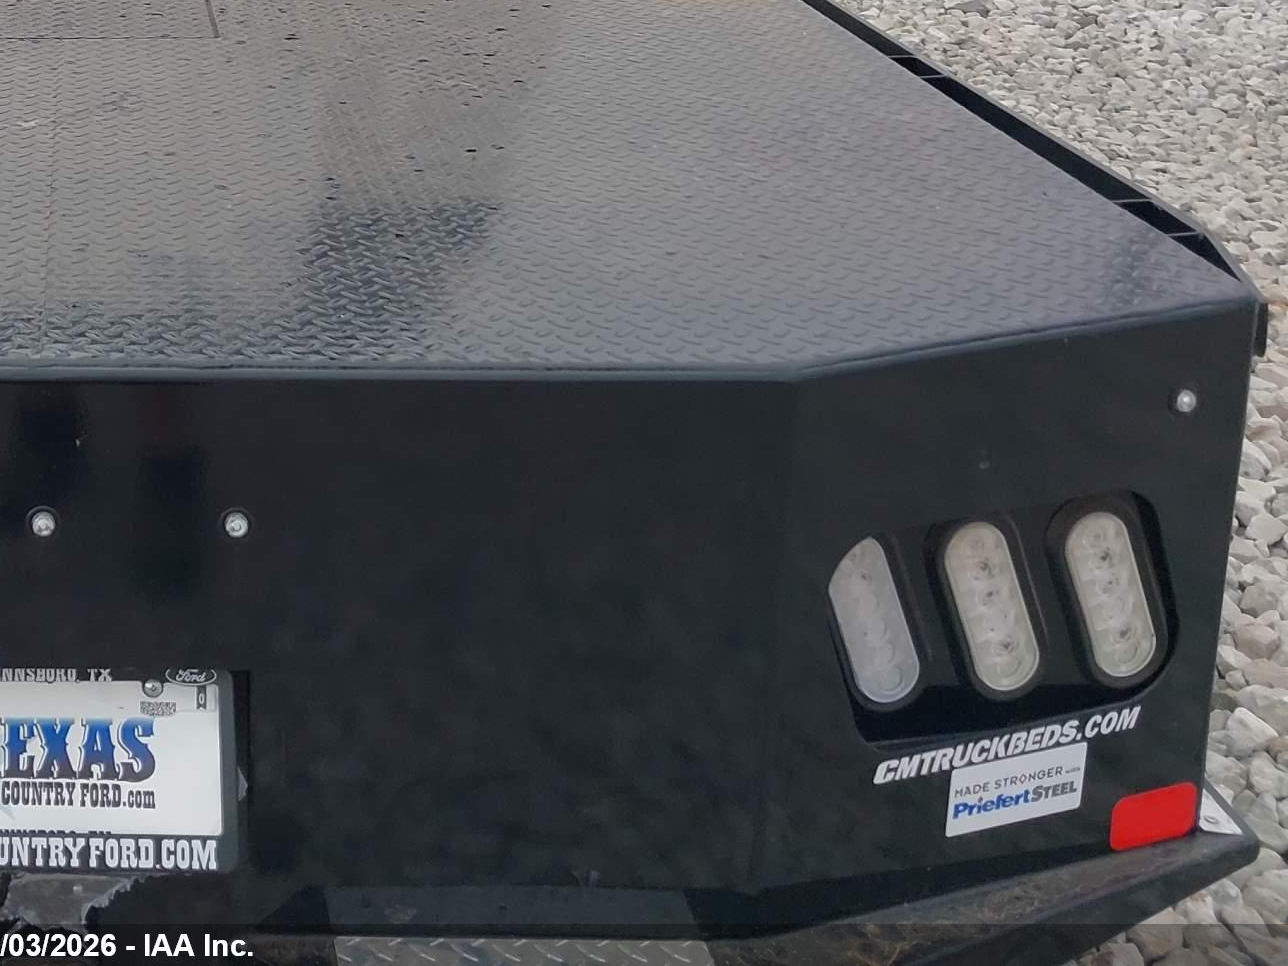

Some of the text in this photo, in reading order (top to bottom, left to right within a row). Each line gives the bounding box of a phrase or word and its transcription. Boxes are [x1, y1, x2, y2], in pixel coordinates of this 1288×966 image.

[86, 668, 113, 683] TX
[175, 668, 207, 683] Ford
[872, 705, 1142, 786] CMTRUCKBEDS.COM
[0, 780, 76, 807] COUNTRY
[953, 765, 1064, 799] MADE STRONGER
